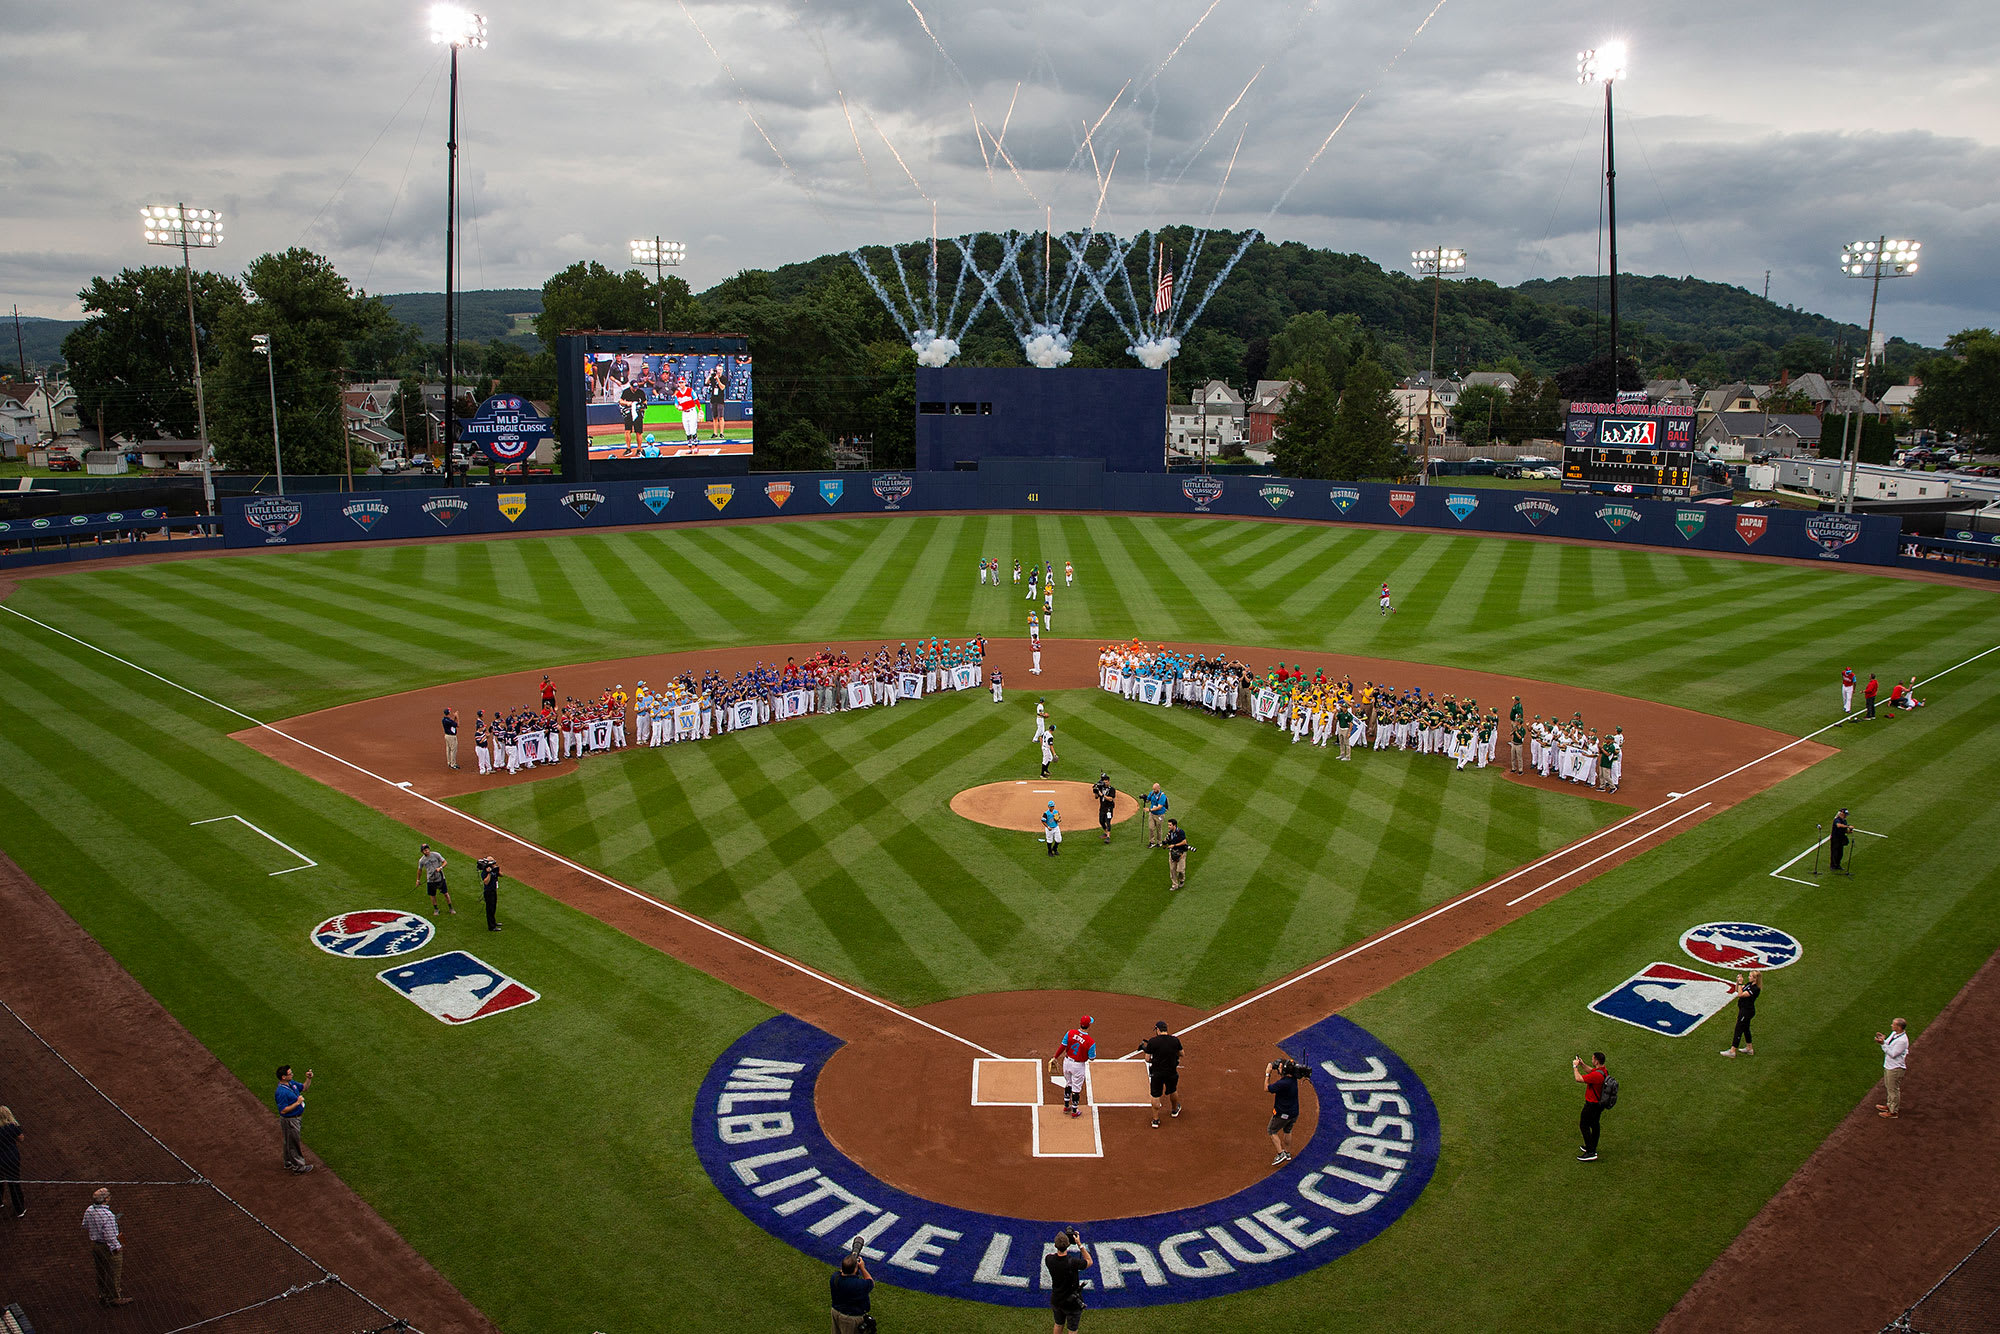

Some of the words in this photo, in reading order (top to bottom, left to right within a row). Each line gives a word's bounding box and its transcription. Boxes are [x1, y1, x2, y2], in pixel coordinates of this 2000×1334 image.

[1571, 402, 1615, 414] HISTORIC
[1616, 404, 1665, 415] BOWMAN
[1667, 405, 1694, 416] FIELD
[1668, 421, 1690, 431] PLAY
[1668, 431, 1689, 440] BALL
[1626, 454, 1632, 462] 0
[1652, 456, 1658, 464] 0
[764, 484, 795, 494] SOUTHWEST
[1259, 487, 1294, 498] ASIA-PACIFIC
[1614, 485, 1633, 493] 6:58
[560, 494, 574, 506] NEW
[576, 492, 605, 503] ENGLAND
[638, 490, 675, 501] NORTHWEST
[1027, 493, 1038, 501] 411
[1330, 490, 1360, 500] AUSTRALIA
[1390, 494, 1414, 502] CANADA
[422, 499, 468, 512] MID-ATLANTIC
[1445, 498, 1479, 507] CARIBBEAN
[1514, 501, 1560, 515] EUROPE-AFRICA
[342, 503, 364, 516] GREAT
[367, 503, 389, 514] LAKES
[1595, 508, 1612, 519] LATIN
[1614, 508, 1642, 522] AMERICA
[1678, 513, 1704, 522] MEXICO
[1740, 518, 1763, 527] JAPAN
[1831, 522, 1858, 531] LEAGUE
[680, 715, 694, 728] W
[598, 729, 605, 747] C
[1071, 1042, 1080, 1055] 4
[717, 1057, 806, 1144] MLB
[1298, 1056, 1414, 1216] CLASSIC
[730, 1145, 964, 1275] LITTLE
